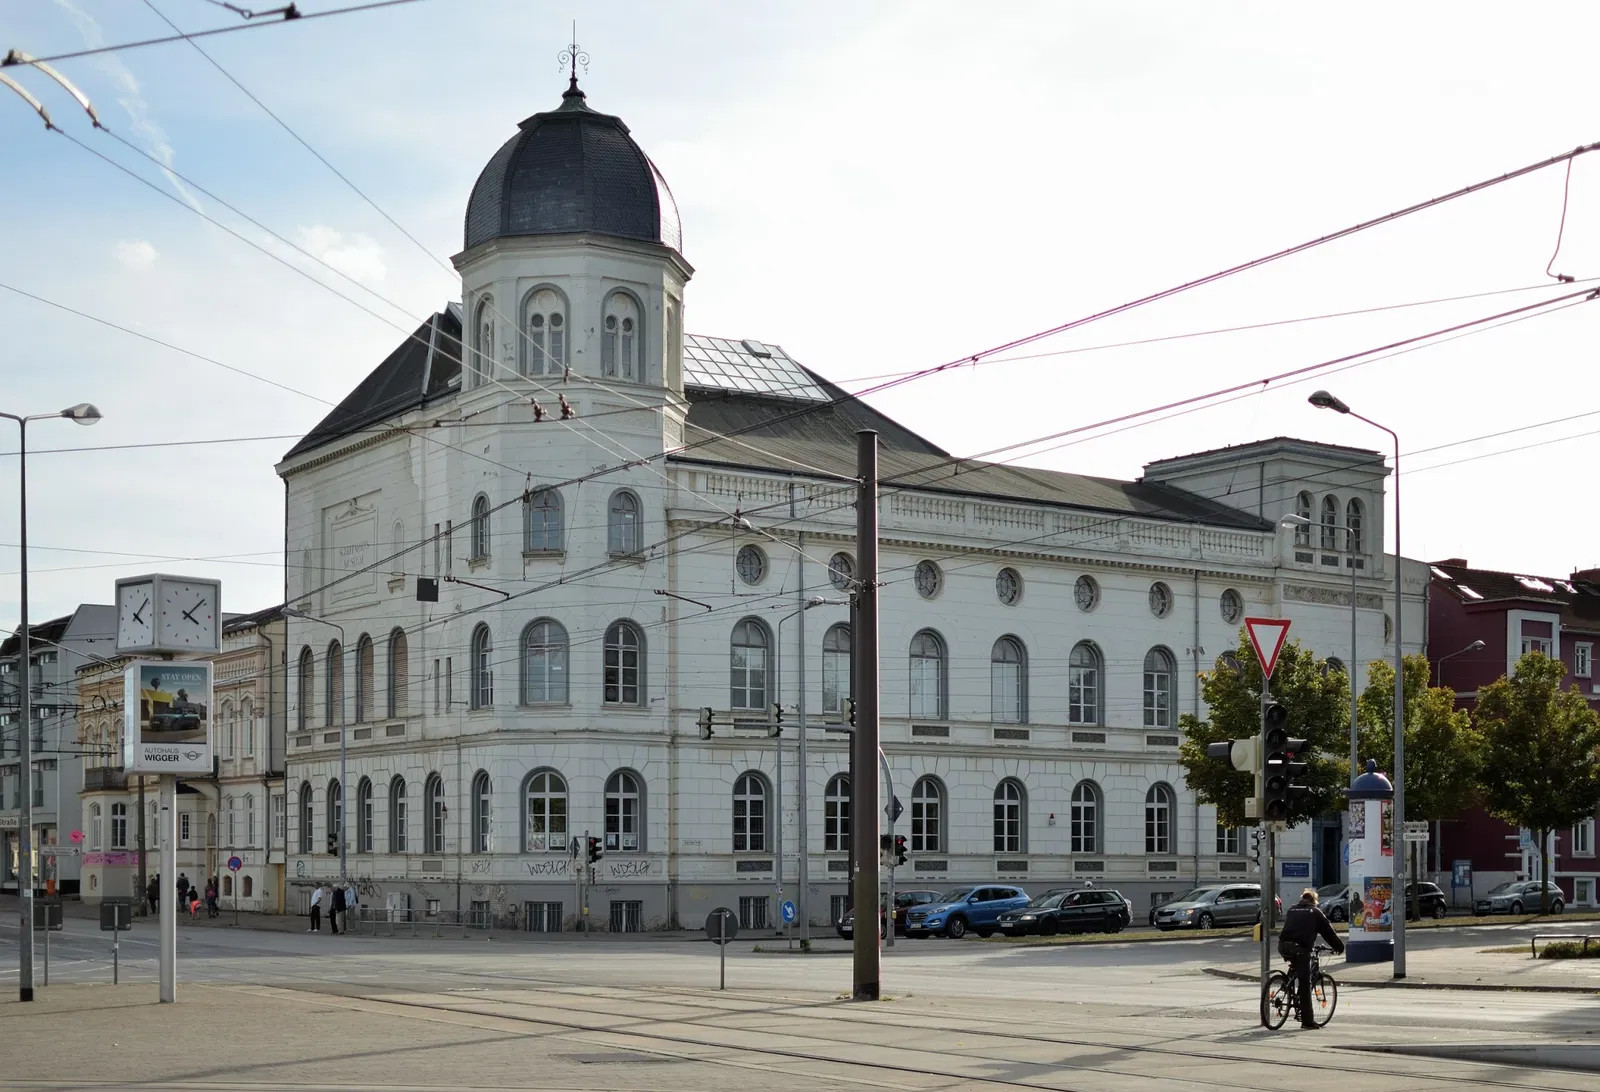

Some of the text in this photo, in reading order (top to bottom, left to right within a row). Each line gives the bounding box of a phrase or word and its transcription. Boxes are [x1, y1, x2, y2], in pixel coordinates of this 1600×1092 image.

[161, 673, 202, 681] STAY OPEN
[144, 754, 180, 762] WIGGER
